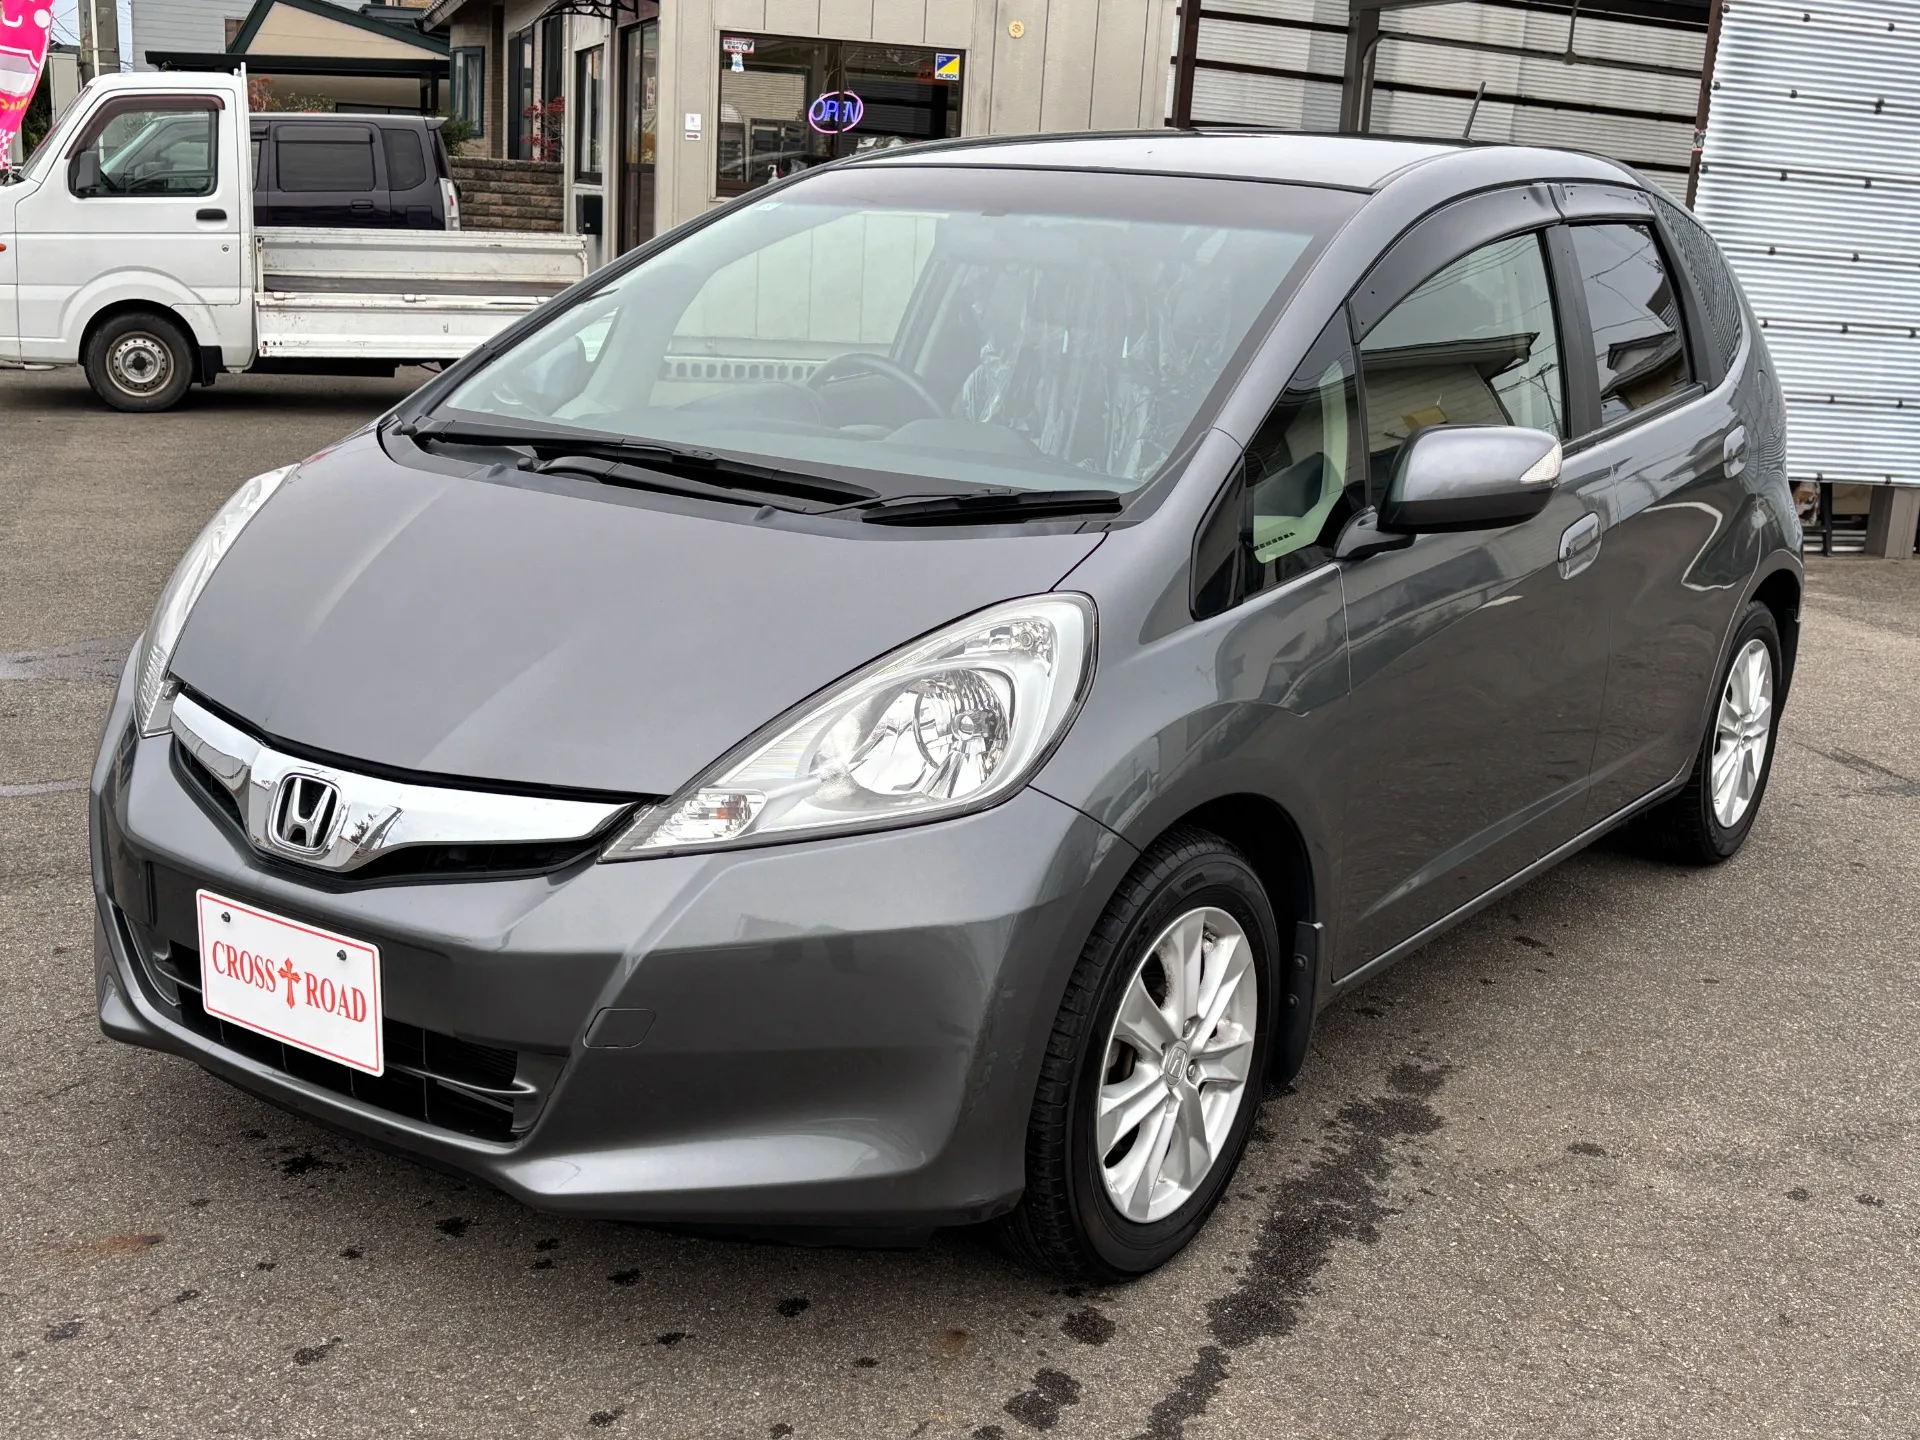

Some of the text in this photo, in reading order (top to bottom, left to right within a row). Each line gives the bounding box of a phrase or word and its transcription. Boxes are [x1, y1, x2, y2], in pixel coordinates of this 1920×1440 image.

[811, 99, 861, 123] OPEN
[212, 940, 367, 1023] CROSS ROAD
